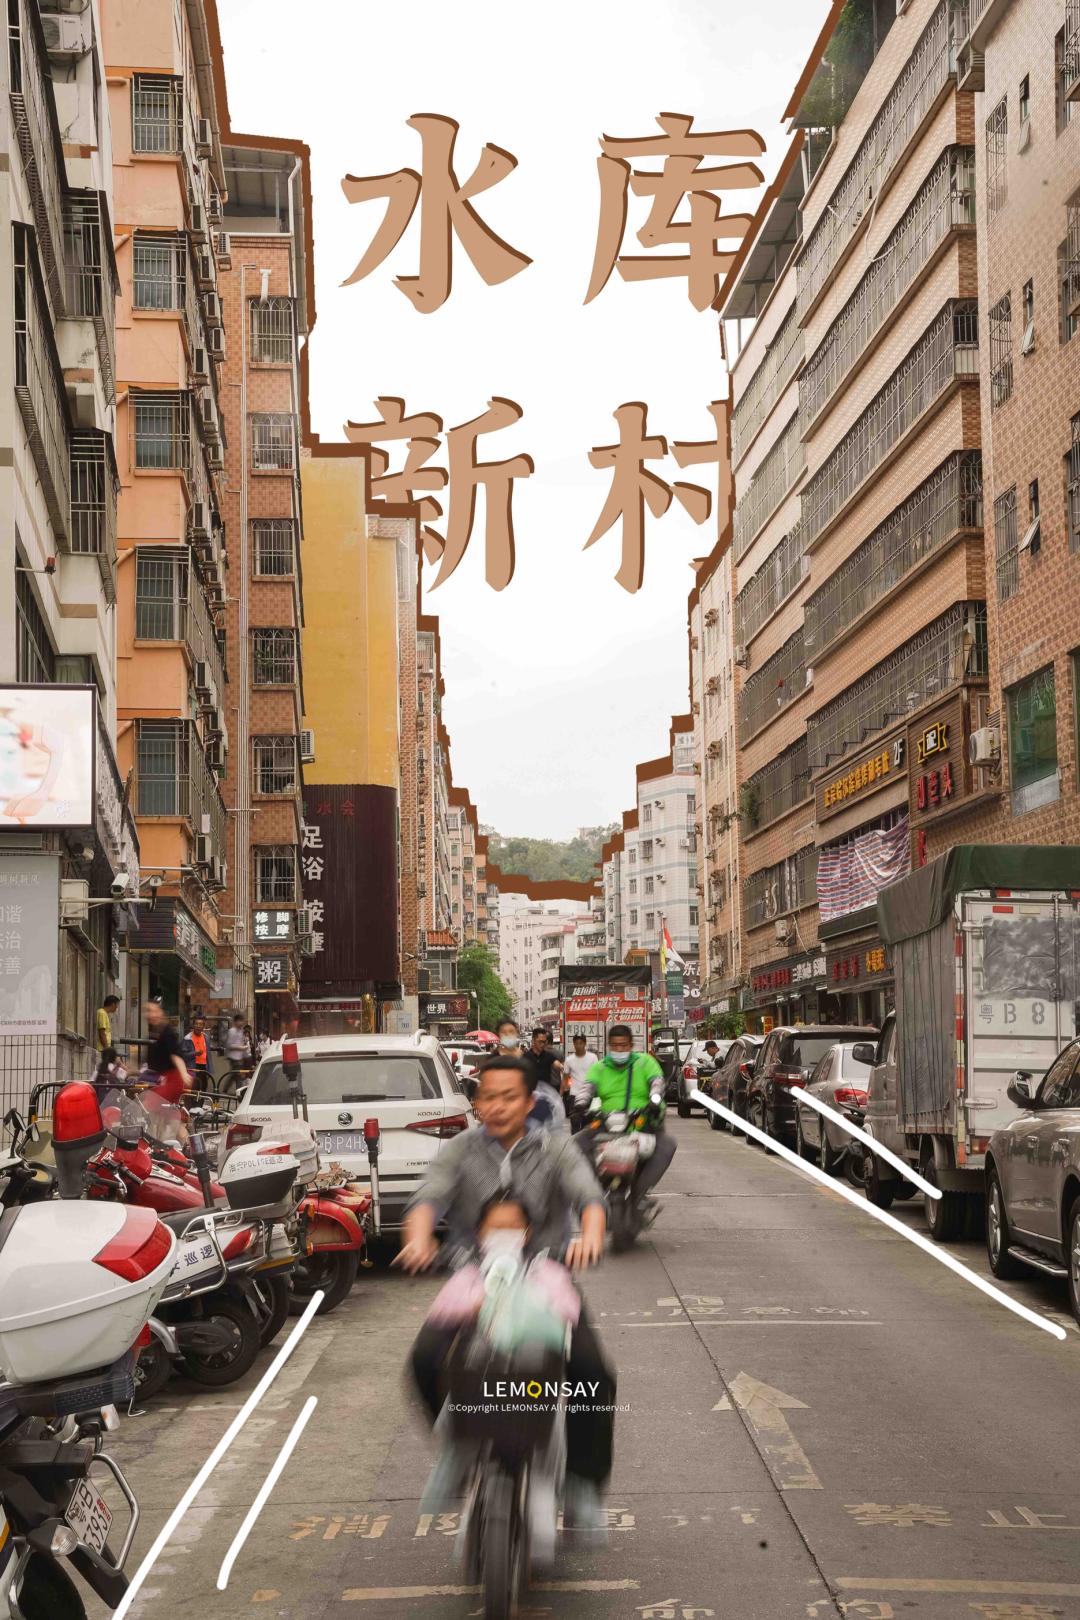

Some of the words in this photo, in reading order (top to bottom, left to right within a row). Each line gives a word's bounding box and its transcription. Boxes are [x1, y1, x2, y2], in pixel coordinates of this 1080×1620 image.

[255, 924, 290, 936] 按摩
[257, 960, 281, 984] 粥
[427, 1003, 447, 1015] 世界
